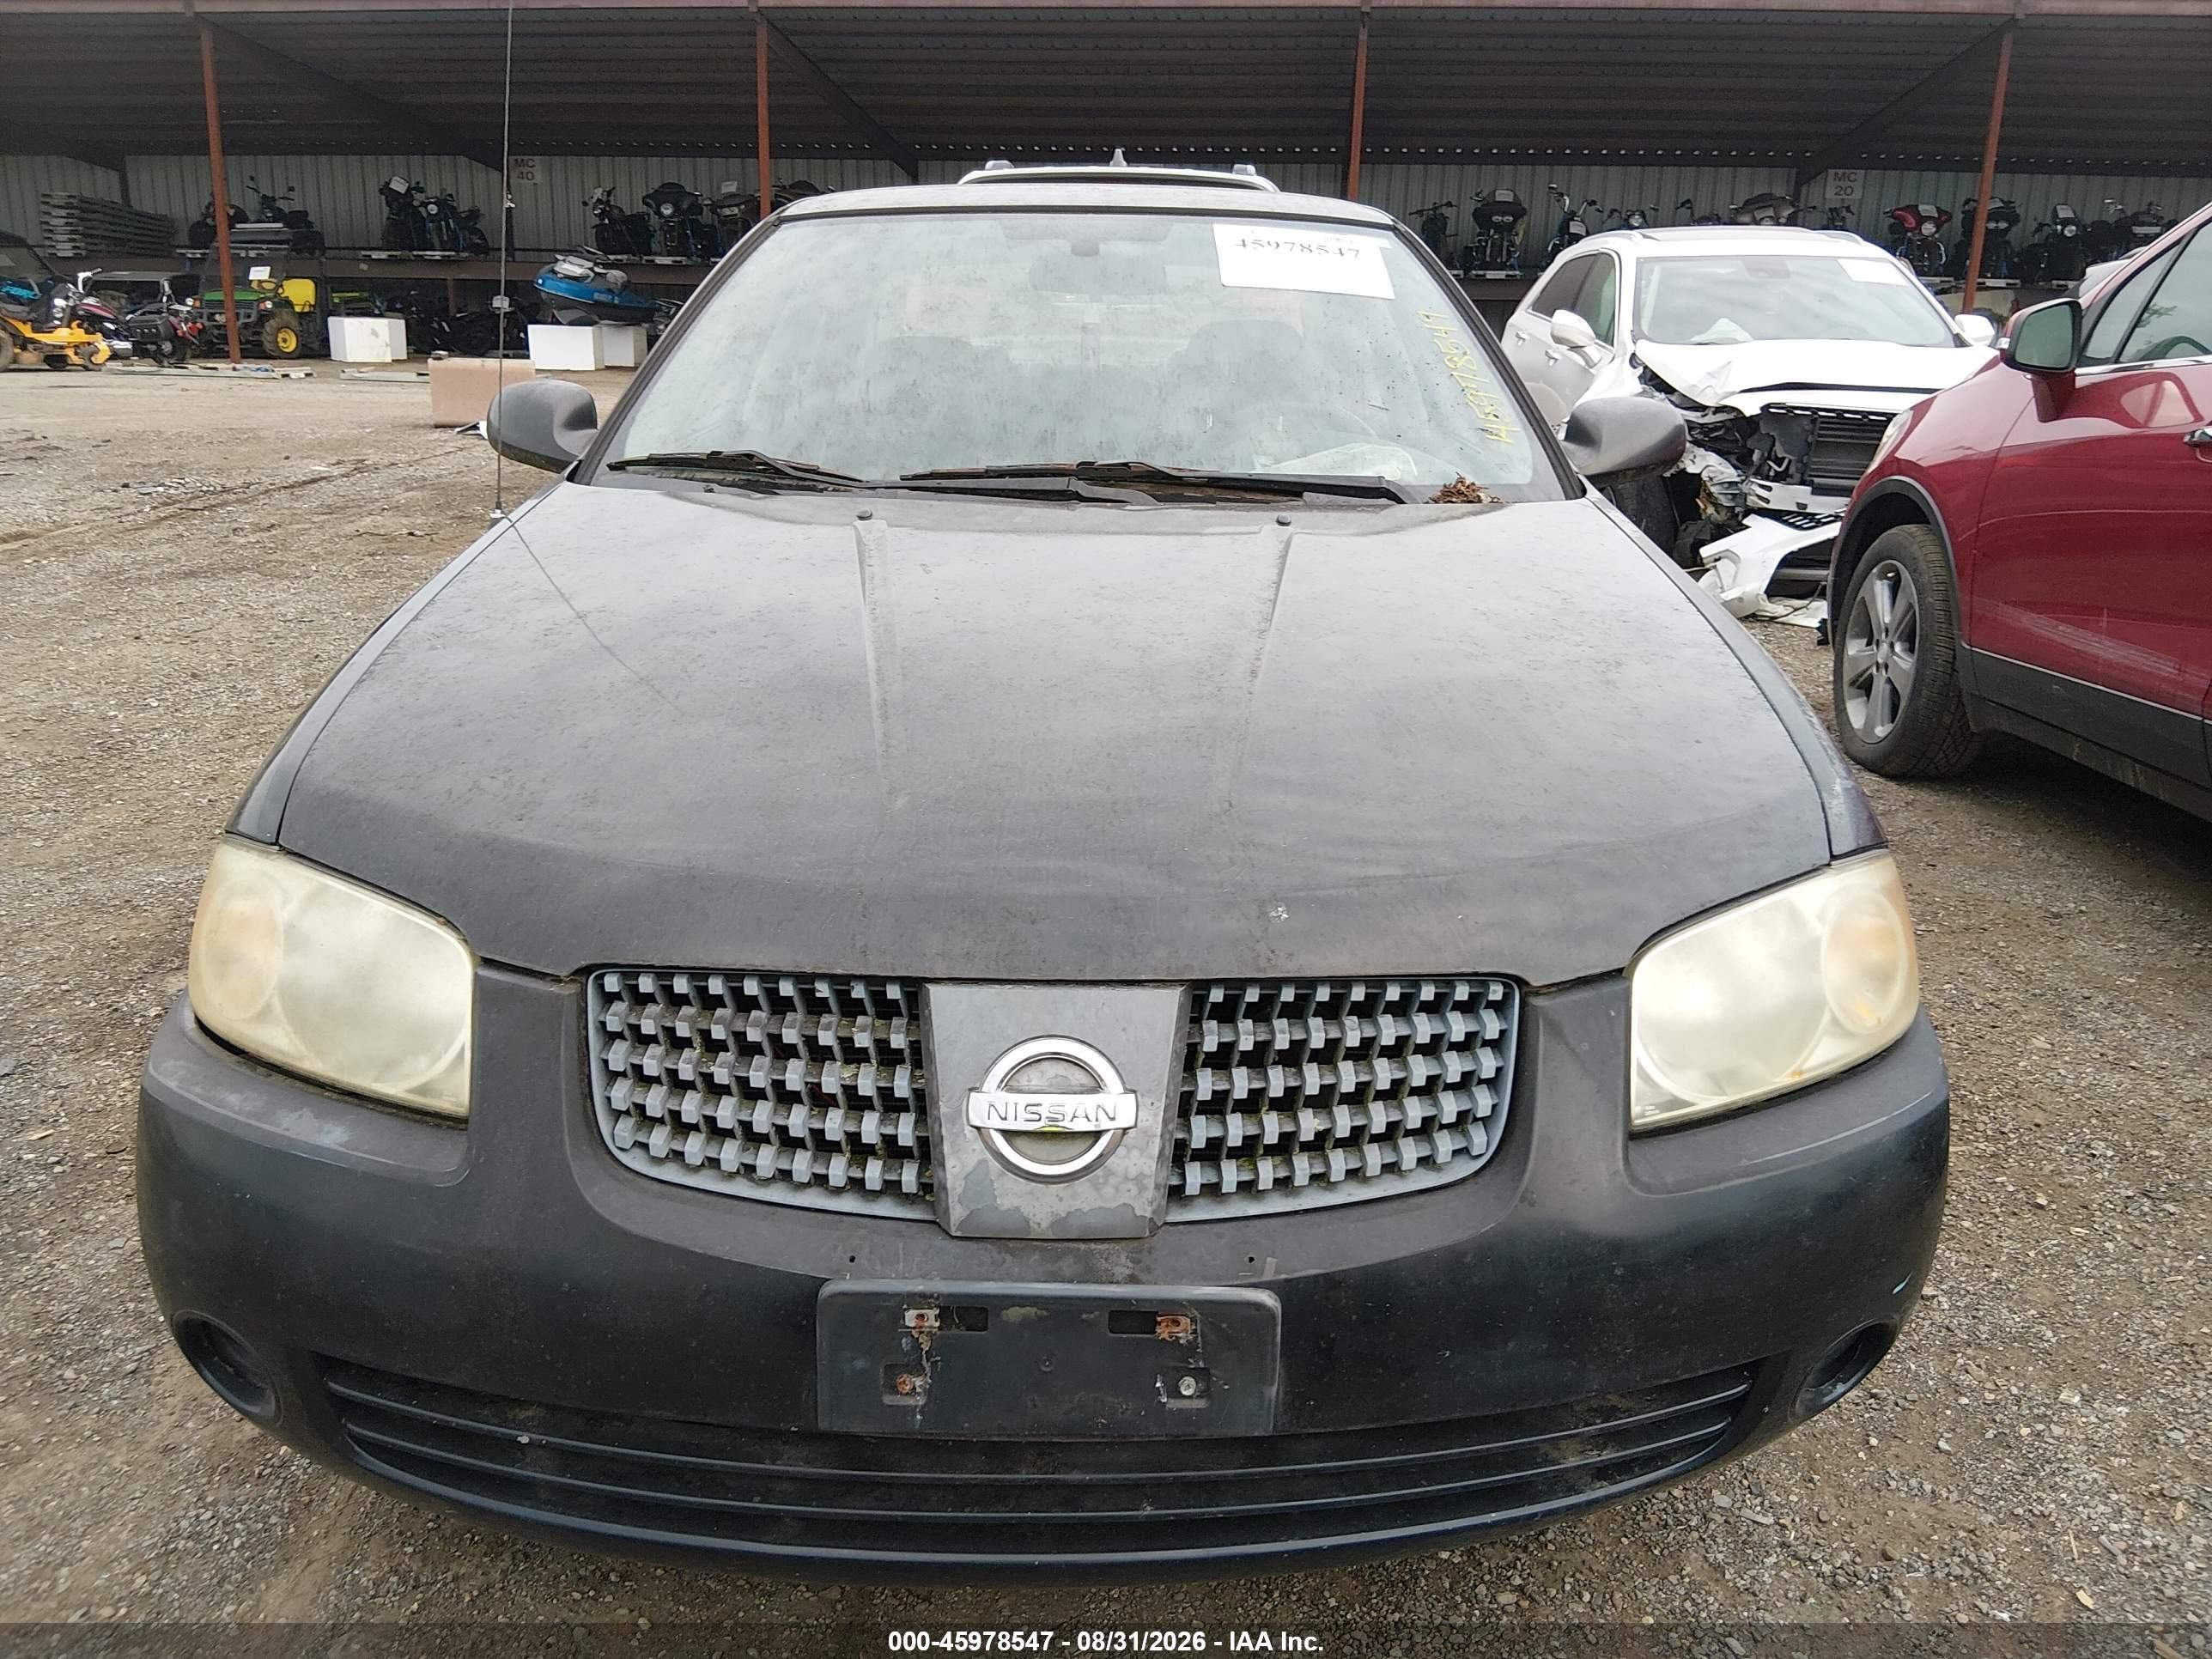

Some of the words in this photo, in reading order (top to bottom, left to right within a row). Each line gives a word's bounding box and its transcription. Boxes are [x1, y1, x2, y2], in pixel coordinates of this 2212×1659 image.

[514, 158, 537, 168] MC
[516, 171, 536, 181] 40
[1833, 172, 1857, 182] MC
[1834, 185, 1855, 197] 20
[1236, 237, 1360, 258] 45978547
[1417, 310, 1522, 445] 45978547
[987, 1102, 1117, 1123] NISSAN
